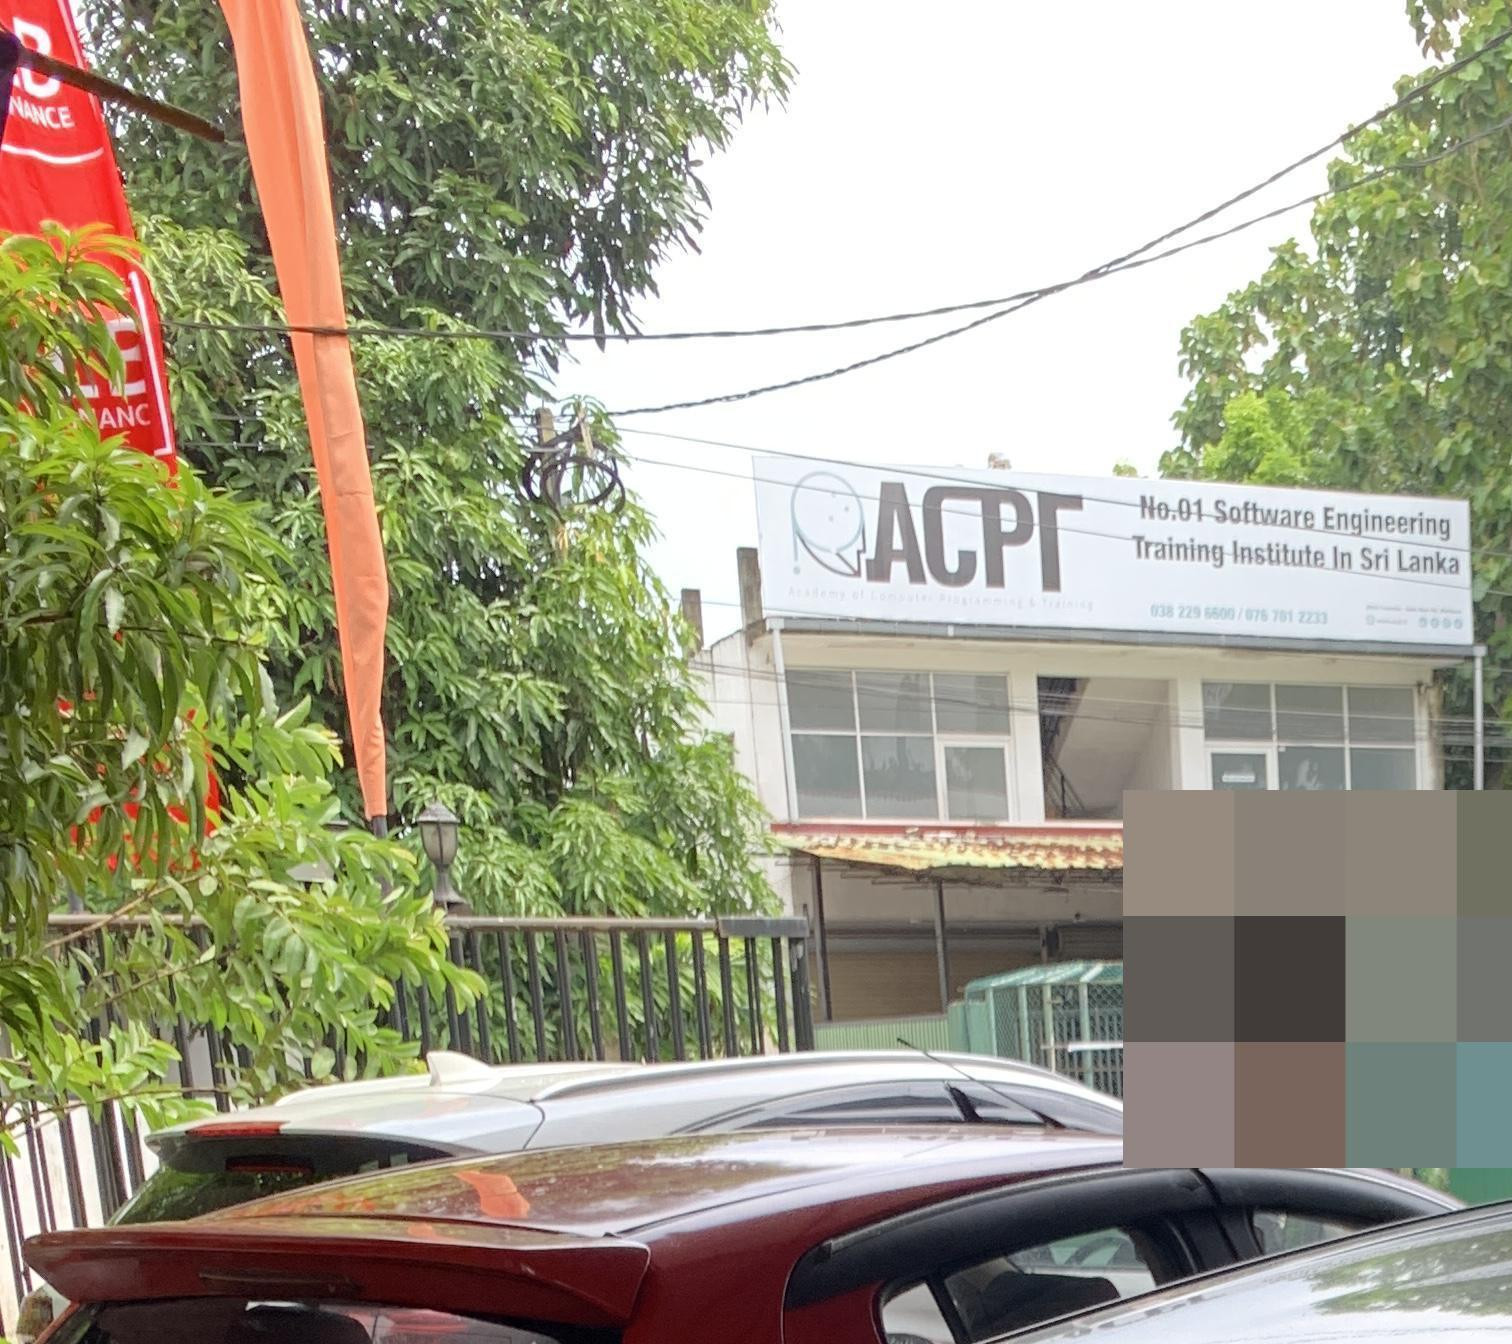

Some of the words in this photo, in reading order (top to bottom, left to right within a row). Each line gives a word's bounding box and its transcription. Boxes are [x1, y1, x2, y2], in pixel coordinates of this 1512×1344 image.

[865, 481, 1083, 592] ACPT
[1140, 495, 1203, 522] No.01
[1214, 499, 1315, 529] Software
[1323, 506, 1451, 541] Engineering
[1132, 535, 1224, 567] Training
[1232, 540, 1325, 568] Institute
[1333, 545, 1351, 571] In
[1361, 547, 1390, 572] Sri
[1397, 549, 1460, 574] Lanka
